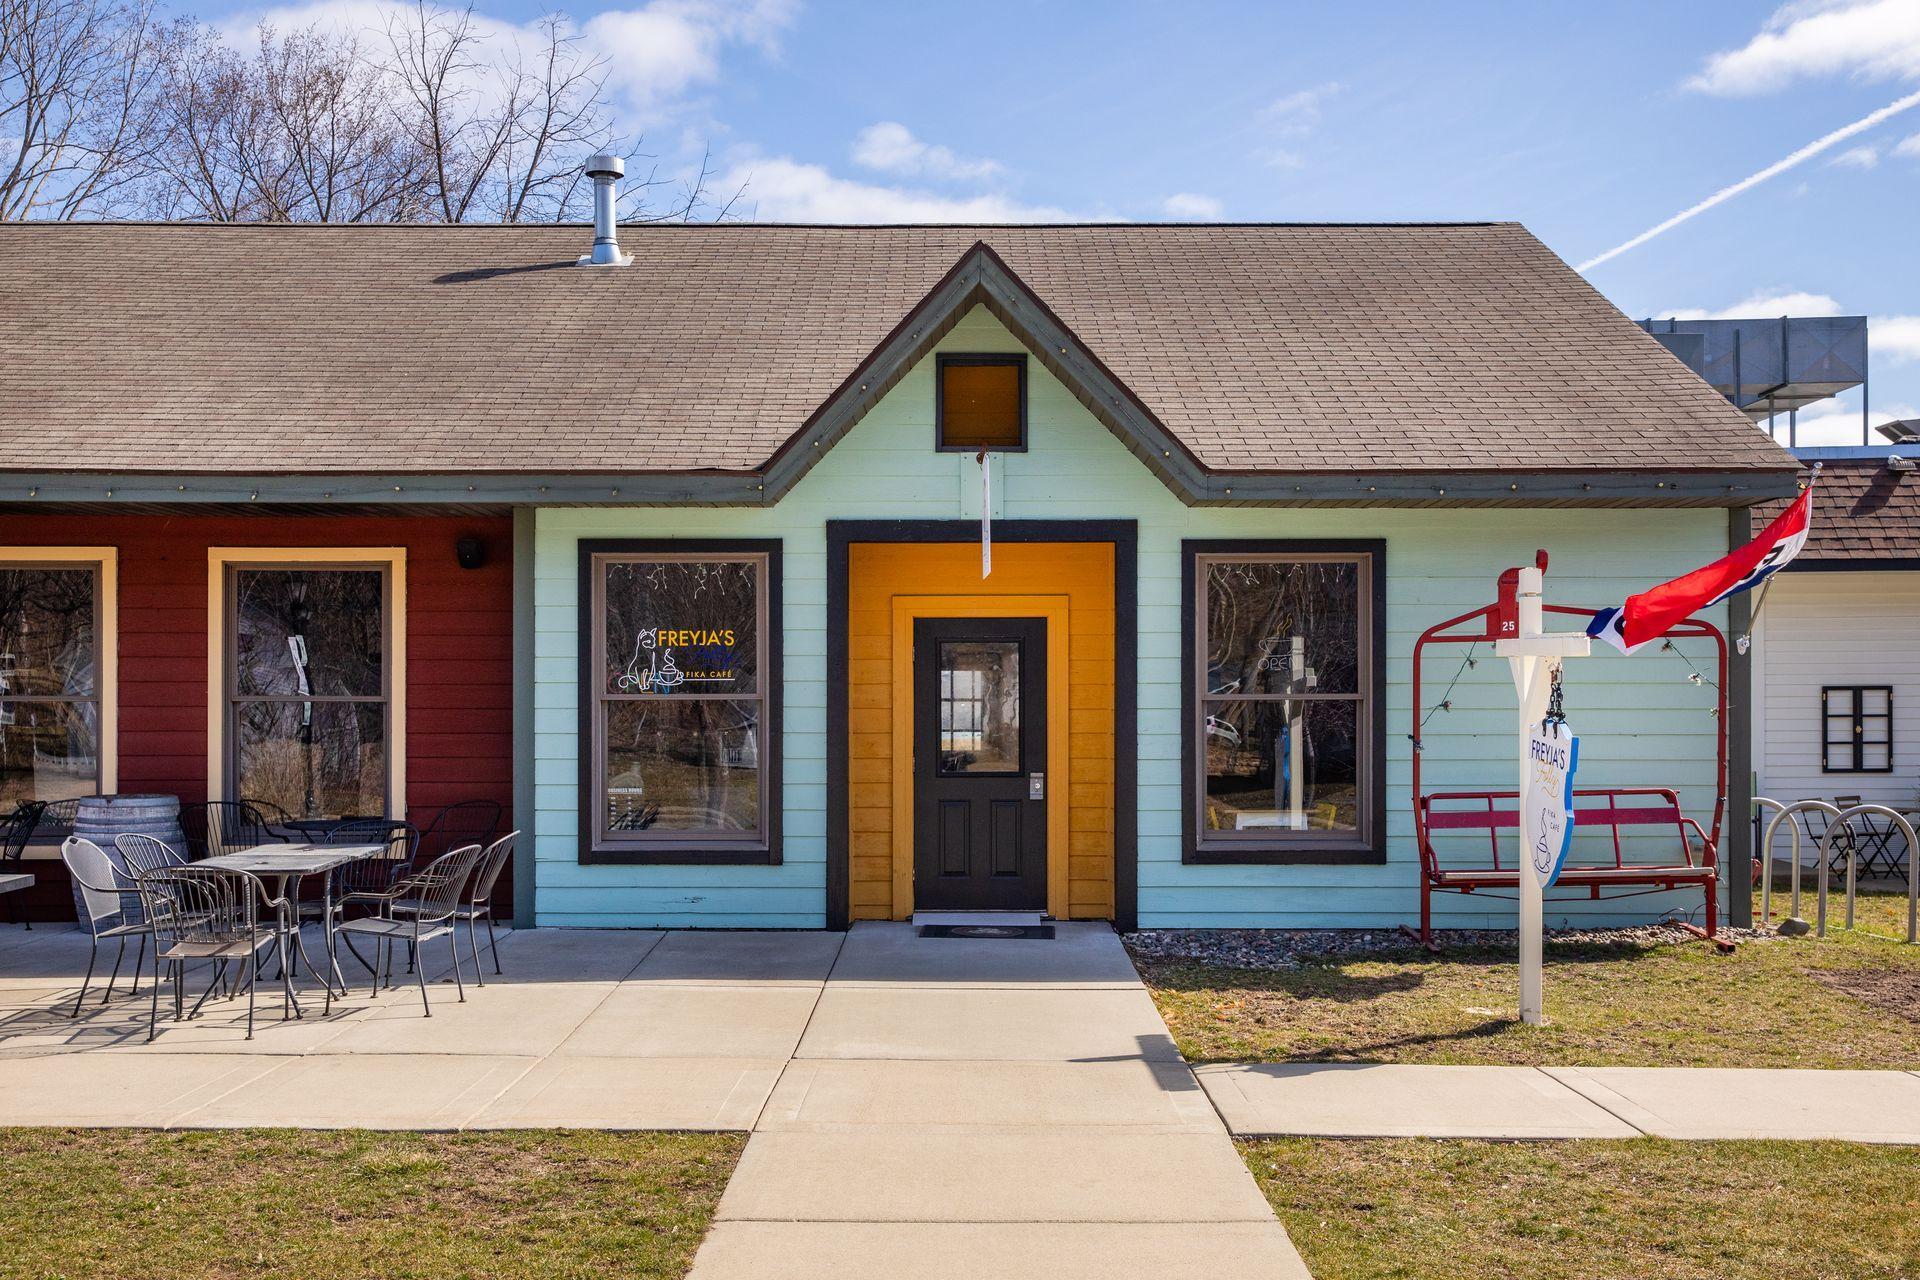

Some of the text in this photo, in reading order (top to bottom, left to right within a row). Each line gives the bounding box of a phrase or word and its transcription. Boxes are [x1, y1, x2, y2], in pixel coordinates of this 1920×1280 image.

[1502, 621, 1515, 631] 25
[657, 629, 736, 647] FREYJA'S
[709, 669, 732, 678] CAFÉ
[1531, 739, 1565, 770] FREYJA'S
